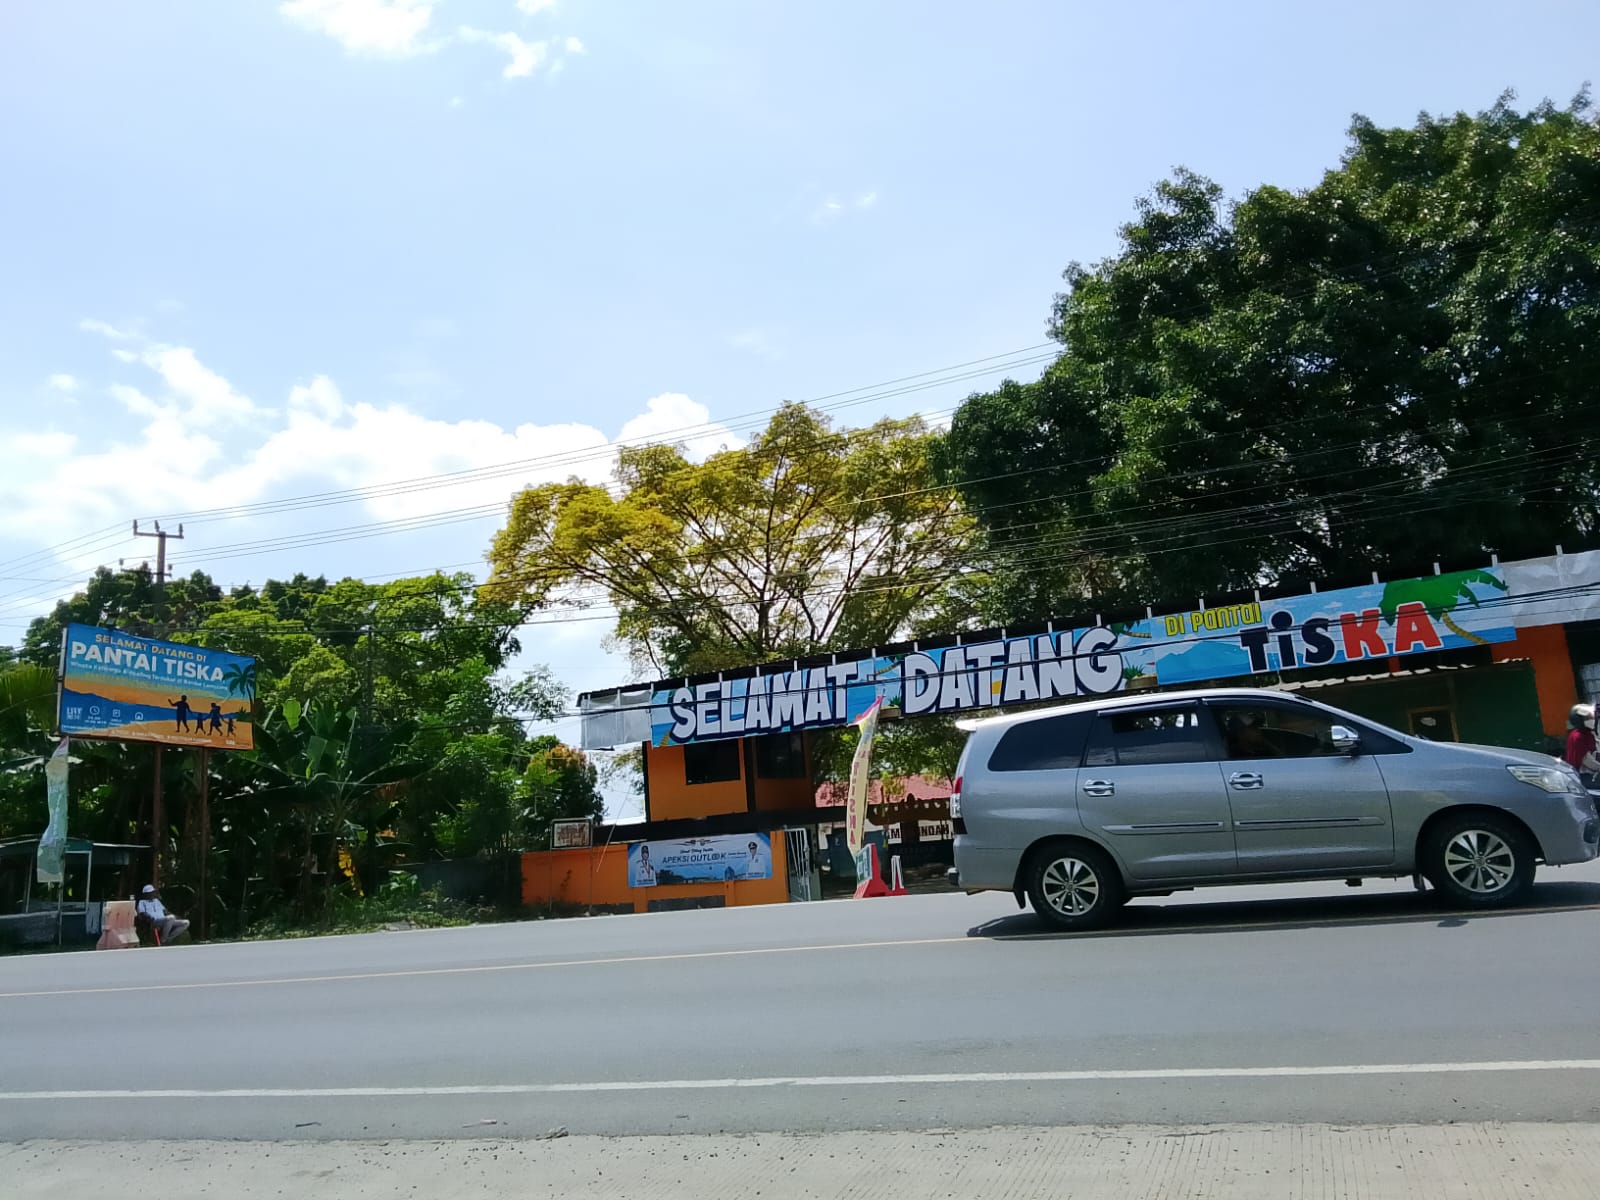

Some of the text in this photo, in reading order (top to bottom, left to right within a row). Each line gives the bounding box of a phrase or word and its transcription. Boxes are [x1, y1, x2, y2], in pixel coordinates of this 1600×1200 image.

[1165, 613, 1185, 637] DI
[71, 641, 157, 672] PANTAI
[164, 657, 225, 682] TISKA
[95, 633, 207, 663] SELAMAT DATANG DI
[670, 626, 1124, 740] SELAMAT DATANG
[662, 855, 689, 864] APEKSI
